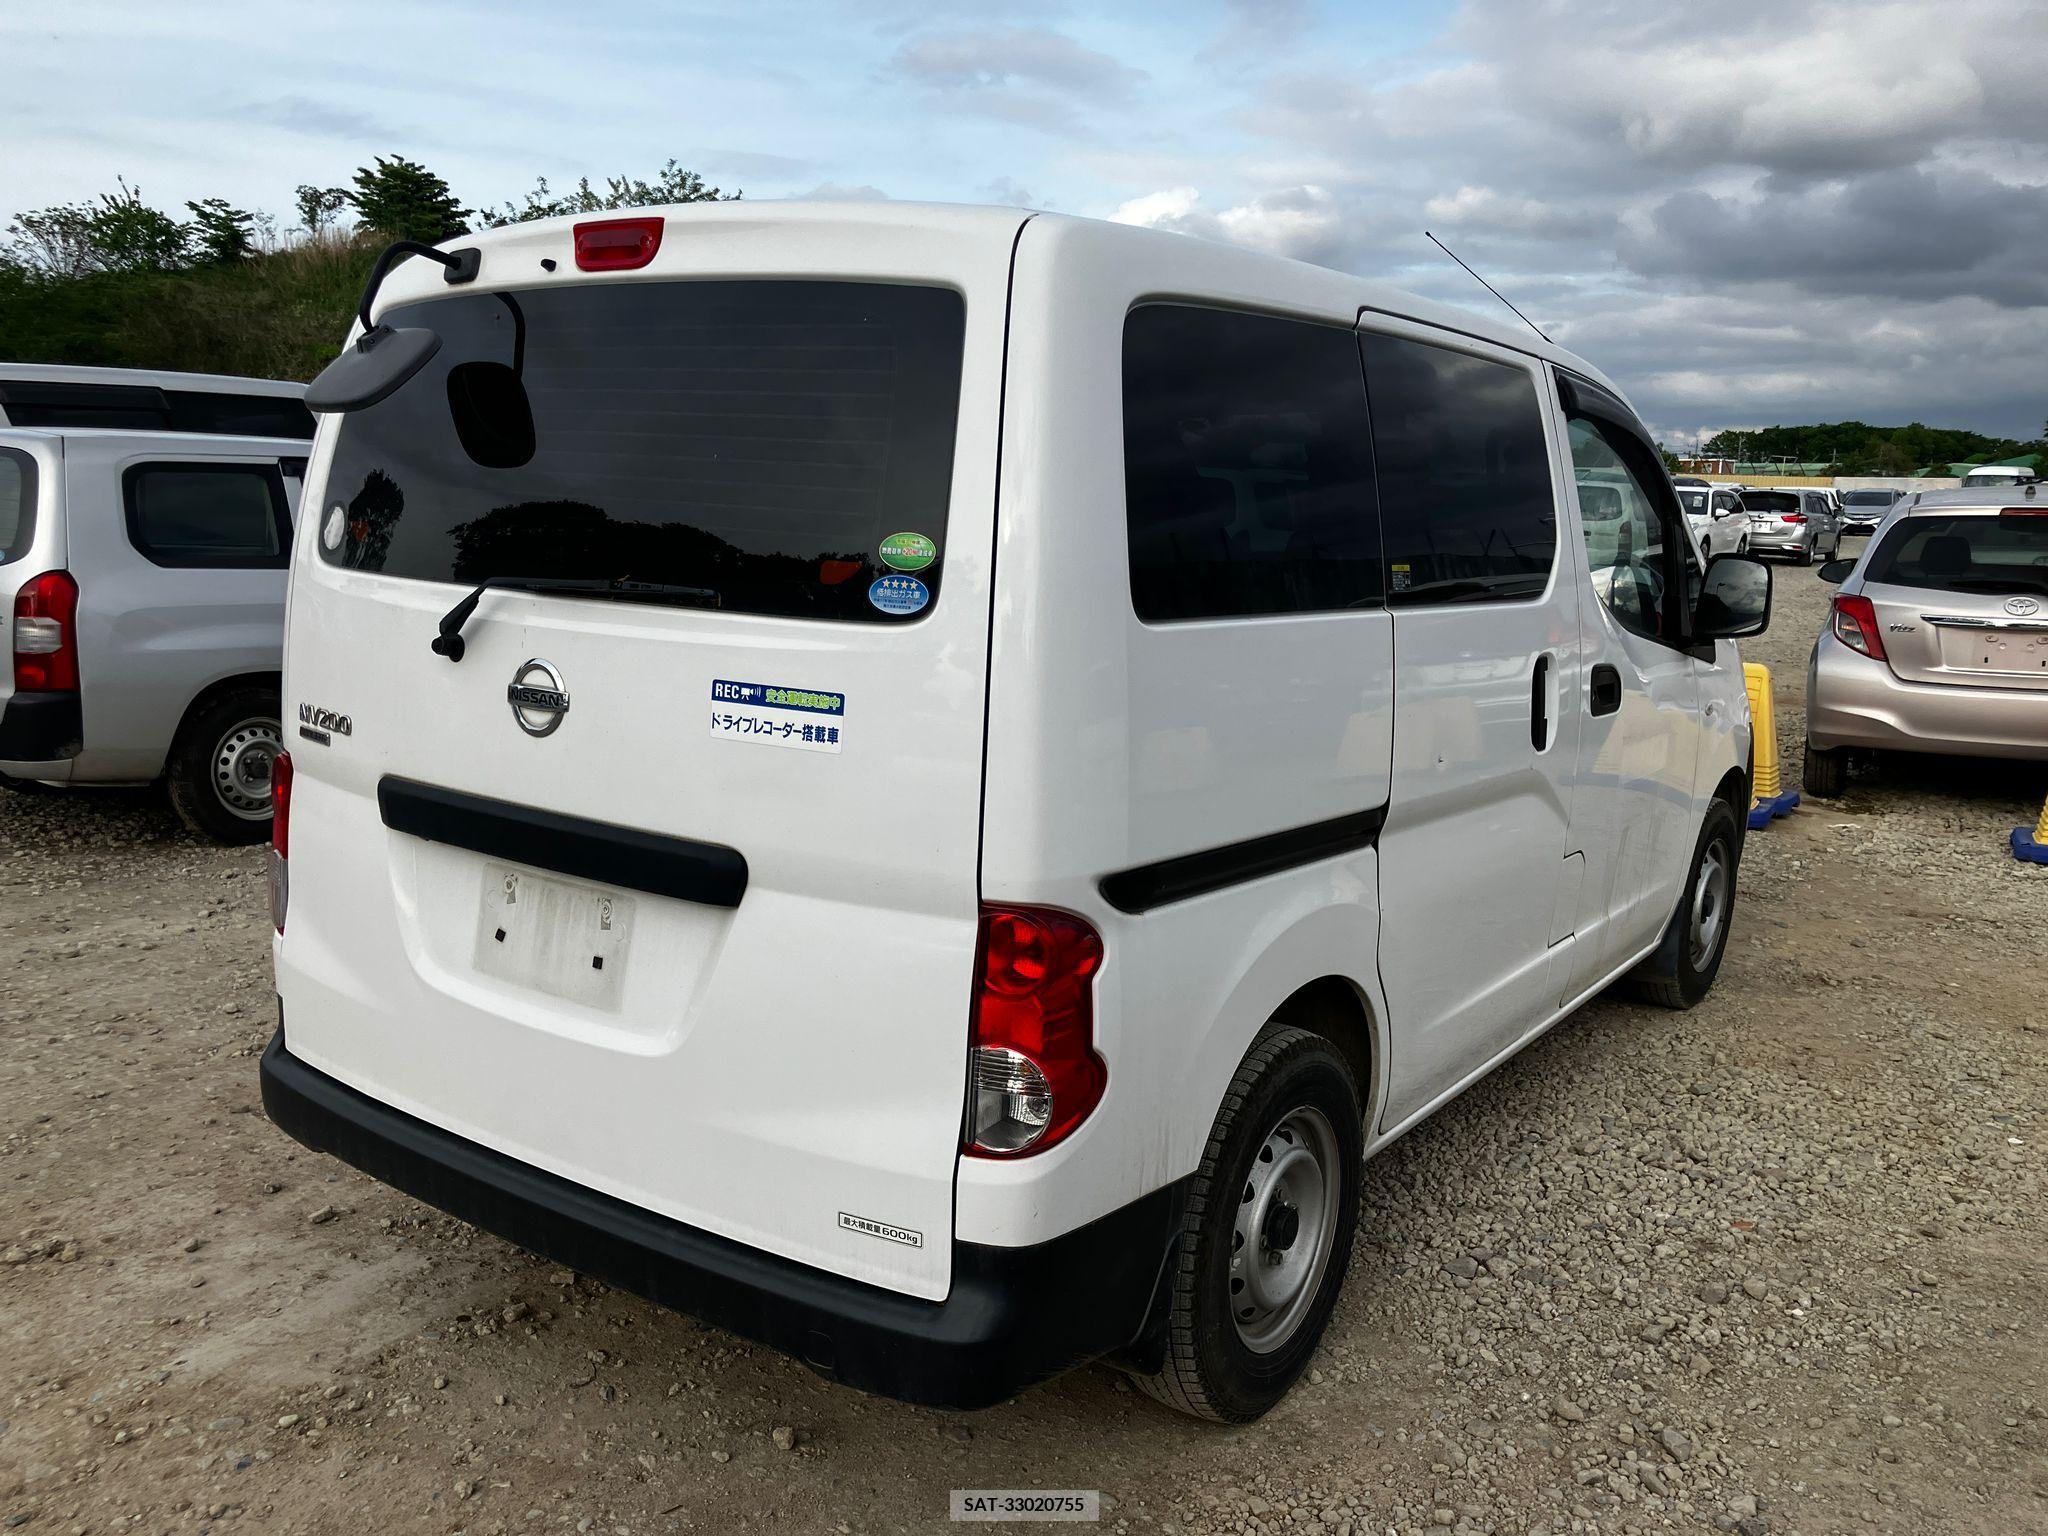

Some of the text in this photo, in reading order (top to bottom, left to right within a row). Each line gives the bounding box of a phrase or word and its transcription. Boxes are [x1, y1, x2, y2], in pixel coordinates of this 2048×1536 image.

[510, 685, 561, 708] NISSAN
[715, 683, 740, 699] REC
[299, 702, 352, 736] NV200
[711, 712, 840, 745] ドライブレコーダー搭載車
